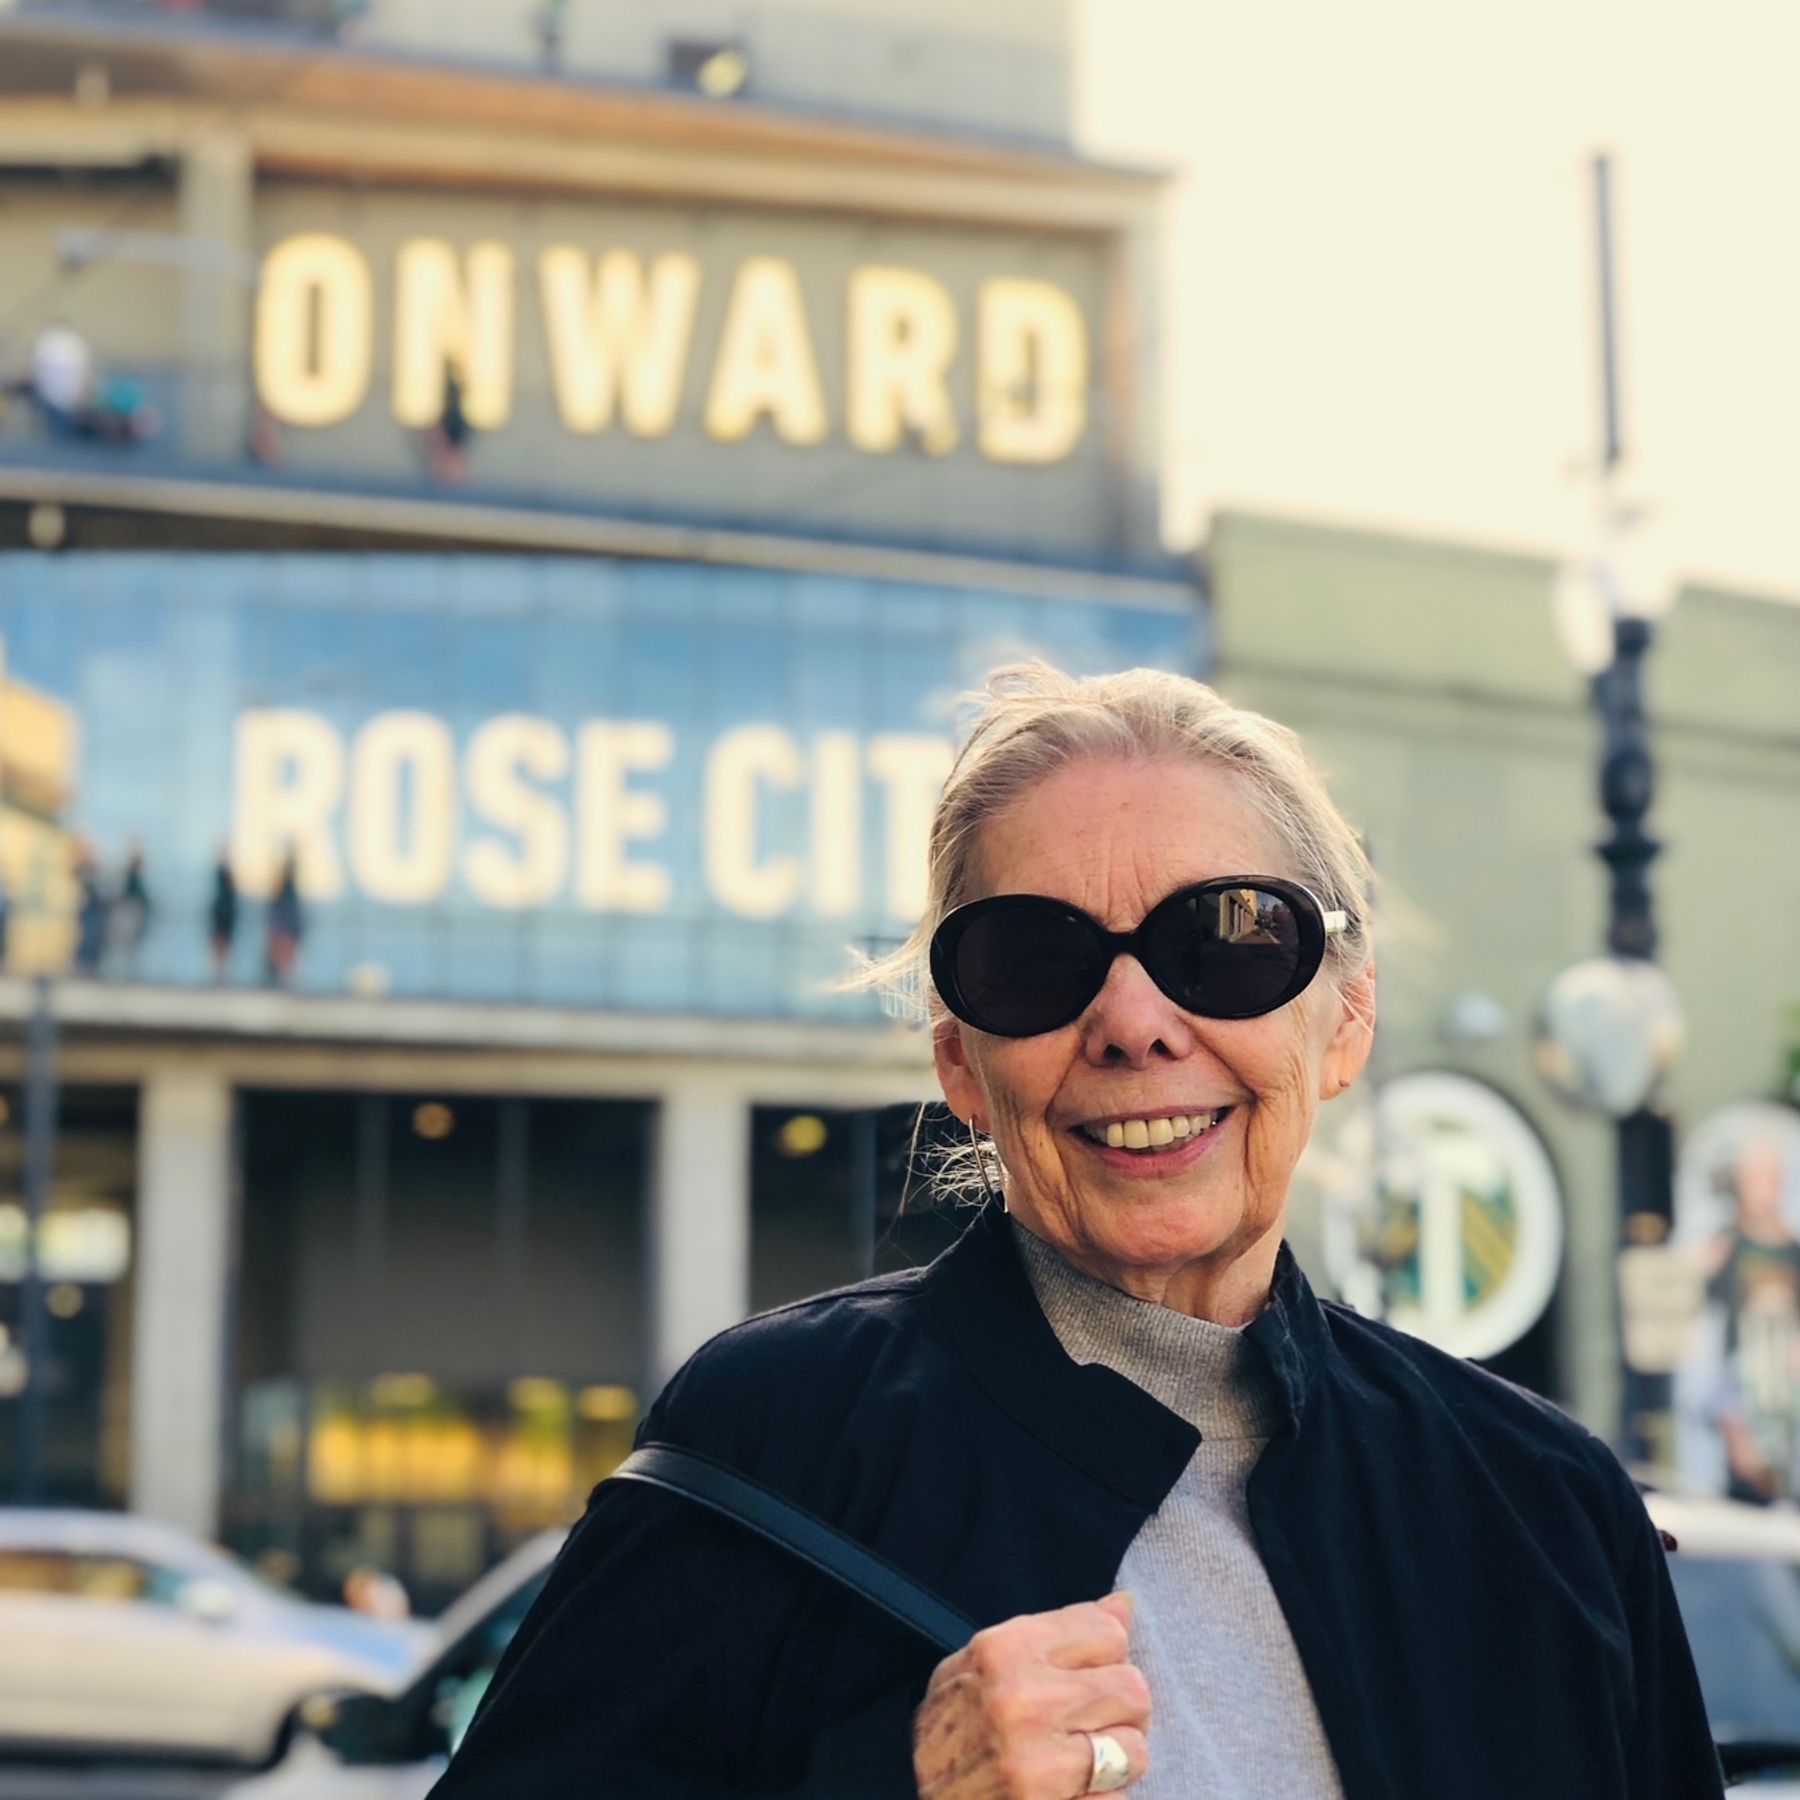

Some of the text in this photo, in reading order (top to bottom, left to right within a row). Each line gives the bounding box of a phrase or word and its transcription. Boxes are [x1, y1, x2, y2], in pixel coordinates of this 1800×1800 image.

[255, 233, 1088, 464] ONWARD
[231, 708, 957, 921] ROSE CIT
